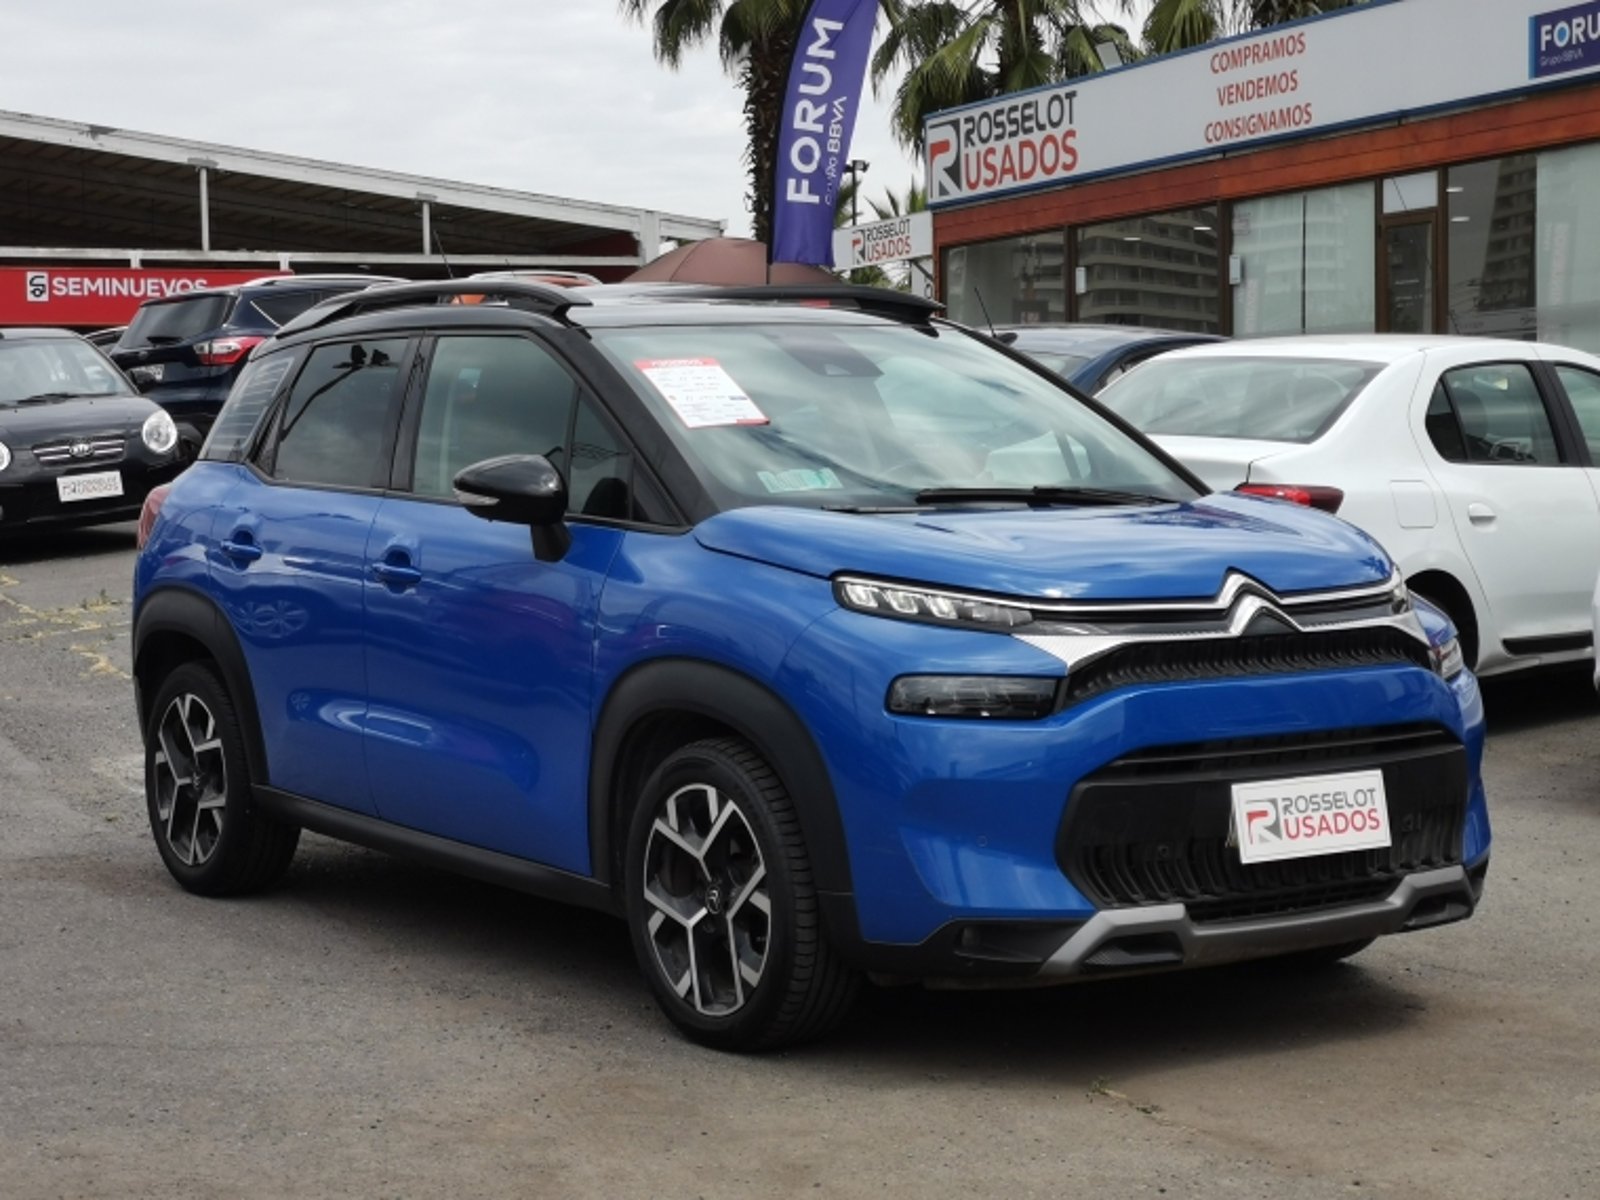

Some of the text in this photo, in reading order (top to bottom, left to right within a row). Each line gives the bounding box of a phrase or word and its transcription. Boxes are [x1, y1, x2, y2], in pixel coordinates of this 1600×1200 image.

[1210, 32, 1306, 74] COMPRAMOS
[1217, 69, 1298, 107] VENDEMOS
[787, 18, 844, 204] FORUM
[827, 96, 848, 153] BBVA
[964, 91, 1077, 148] ROSSELOT
[1204, 102, 1312, 143] CONSIGNAMOS
[964, 129, 1079, 191] USADOS
[866, 219, 911, 242] ROSSELOT
[866, 236, 912, 262] USADOS
[1281, 788, 1376, 815] ROSSELOT
[1284, 808, 1381, 840] USADOS
